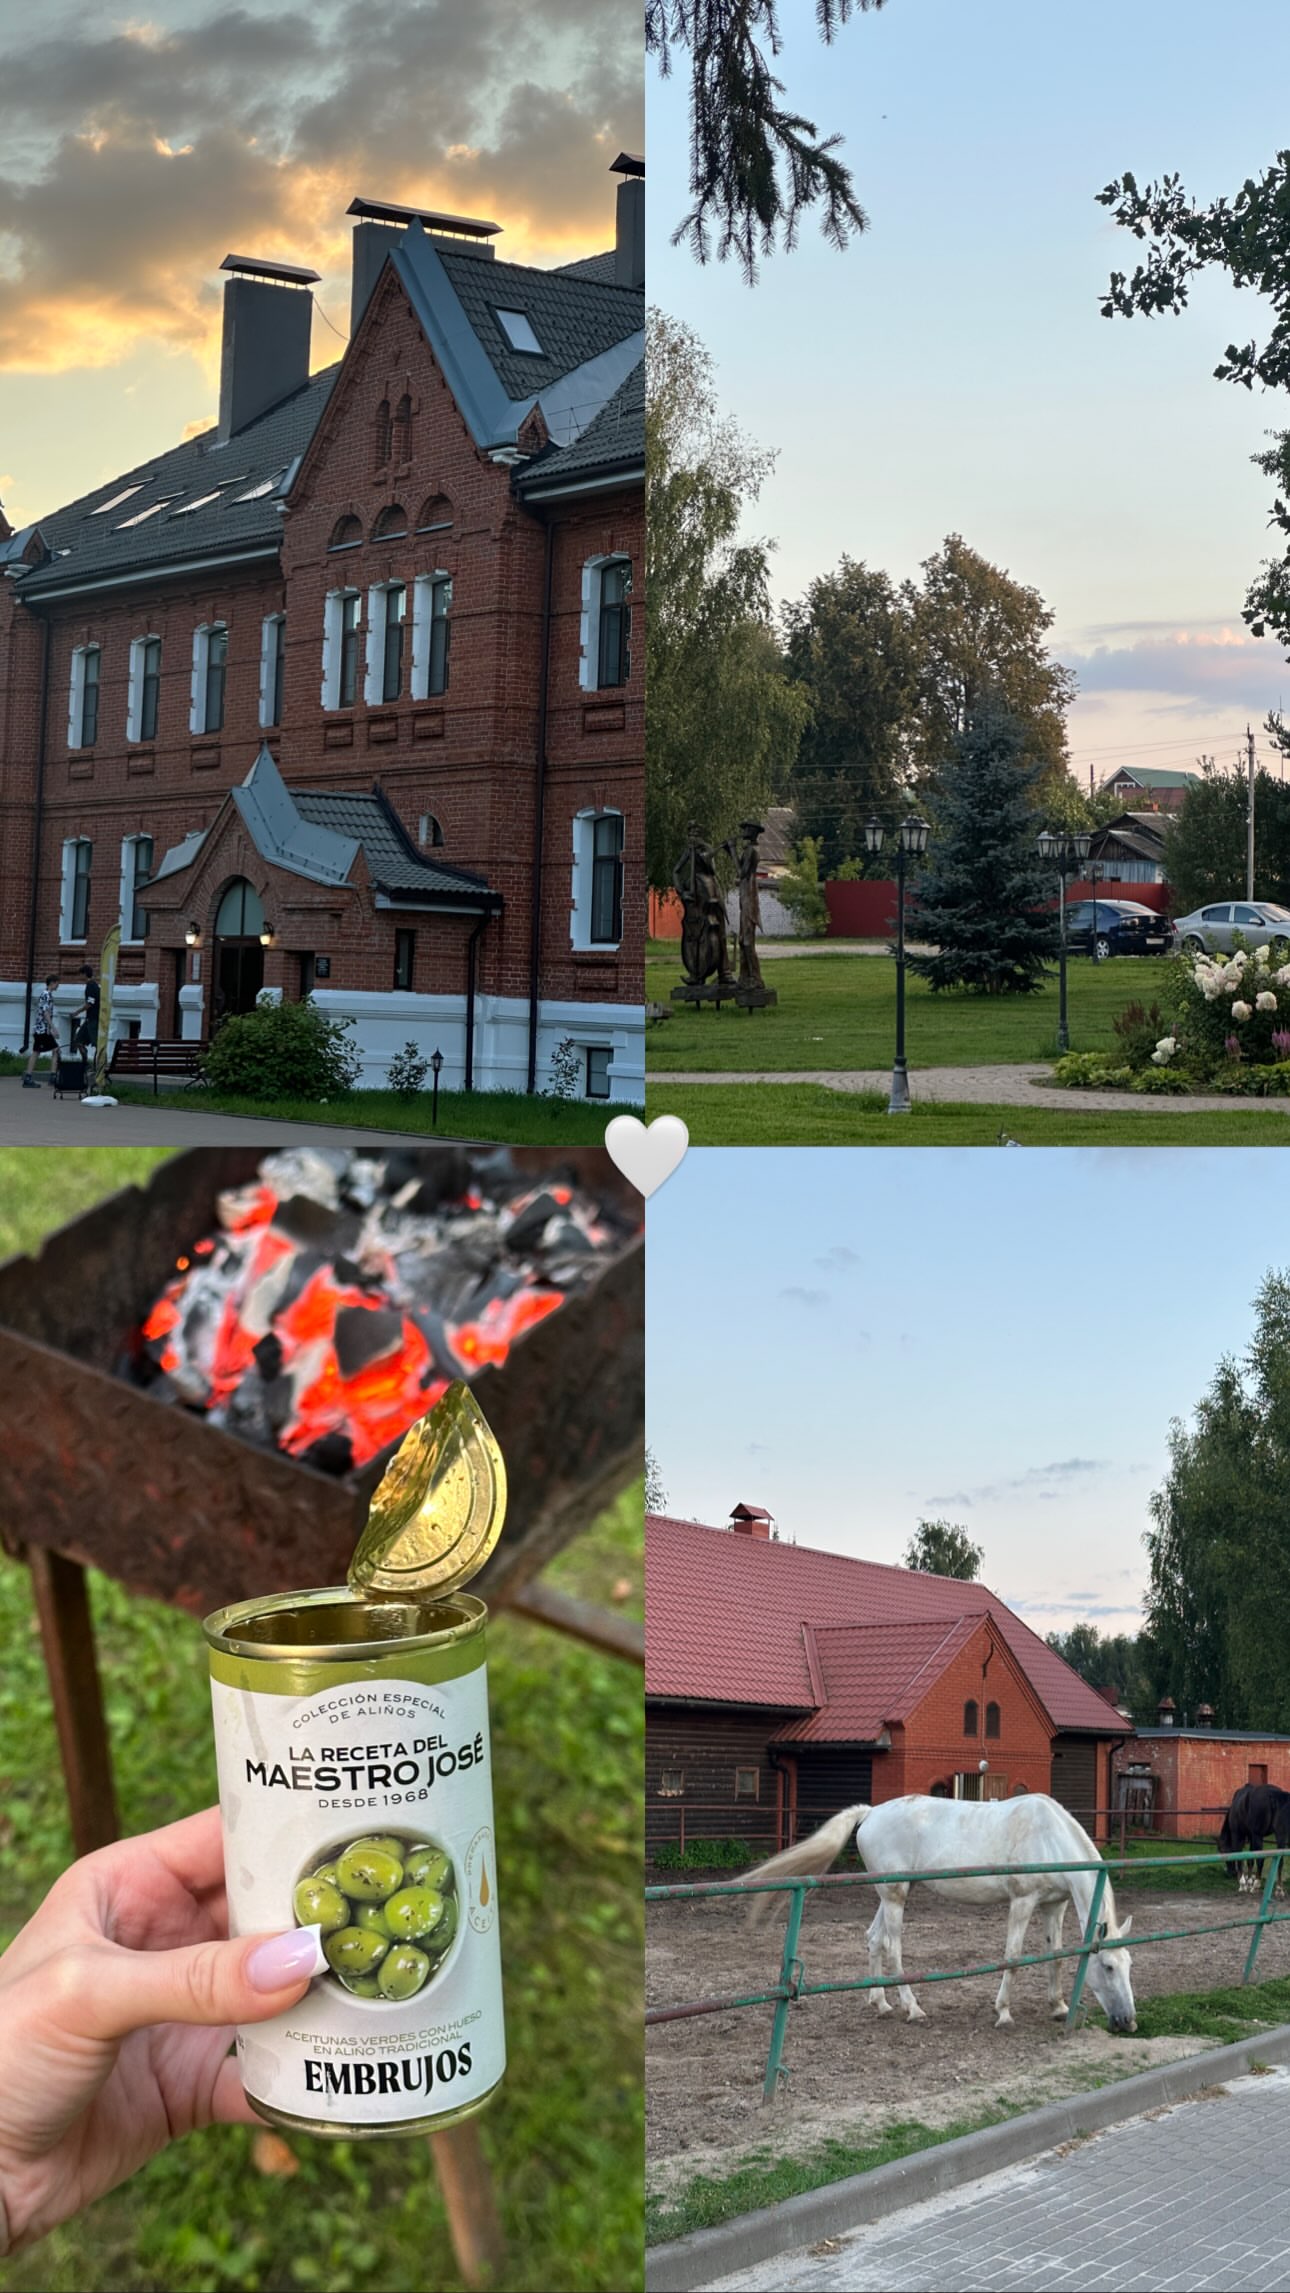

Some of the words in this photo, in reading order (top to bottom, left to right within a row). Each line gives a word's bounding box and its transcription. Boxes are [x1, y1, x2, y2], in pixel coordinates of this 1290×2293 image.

[292, 1693, 377, 1729] COLECCIÓN
[383, 1693, 446, 1719] ESPECIAL
[329, 1710, 351, 1724] DE
[357, 1704, 417, 1719] ALIÑOS
[245, 1759, 420, 1791] MAESTRO
[427, 1732, 484, 1787] JOSÉ
[289, 1746, 315, 1762] LA
[321, 1742, 408, 1762] RECETA
[413, 1734, 449, 1754] DEL
[318, 1797, 377, 1808] DESDE
[383, 1788, 429, 1806] 1968
[285, 2030, 358, 2046] ACEITUNAS
[360, 2032, 417, 2046] VERDES
[419, 2025, 447, 2039] CON
[448, 2010, 483, 2032] HUESO
[313, 2045, 332, 2055] EN
[335, 2046, 376, 2056] ALIÑO
[379, 2032, 463, 2055] TRADICIONAL
[304, 2042, 473, 2097] EMBRUJOS
